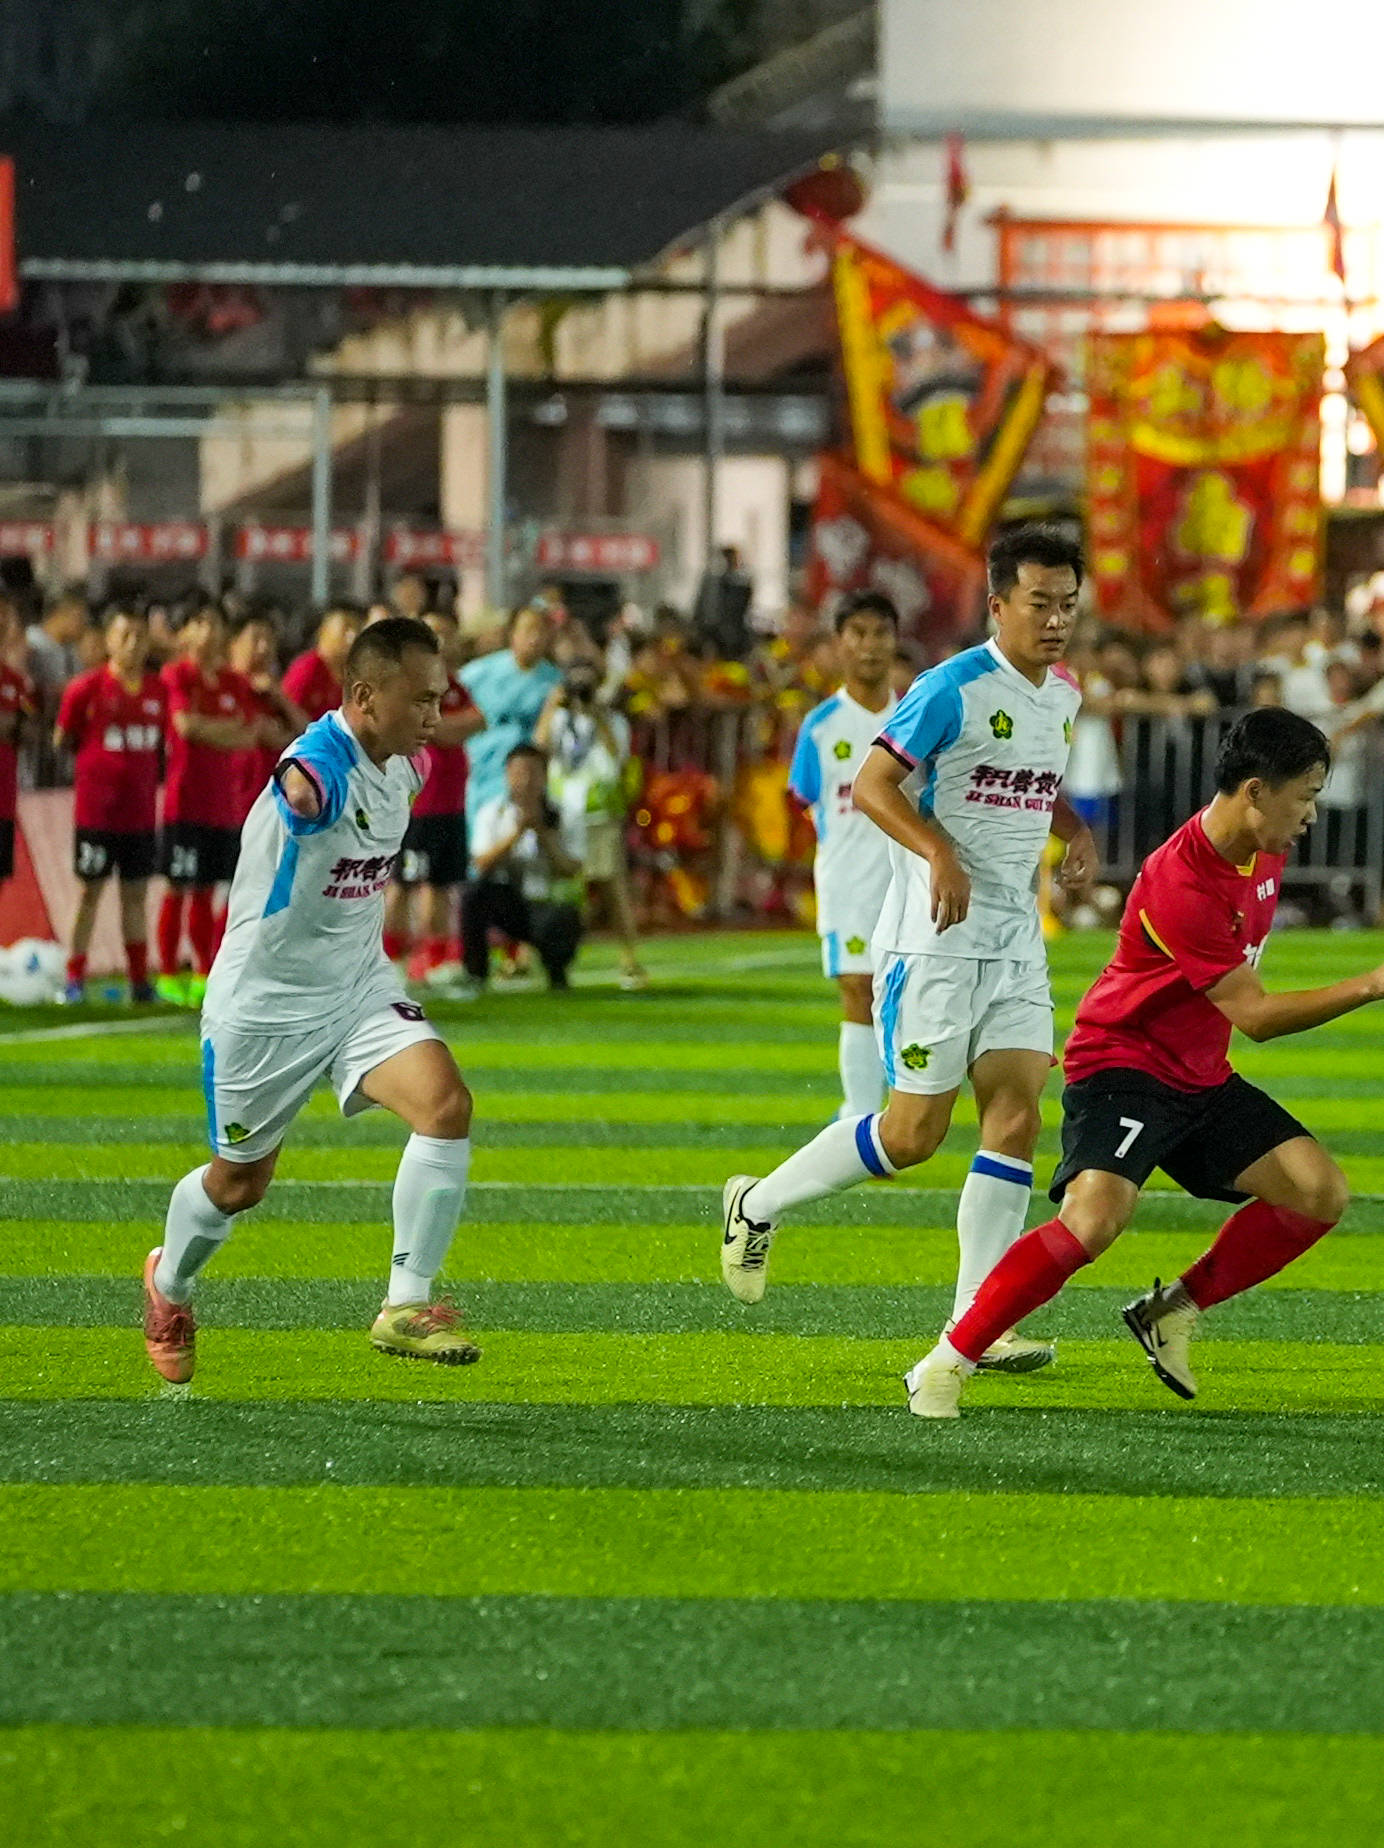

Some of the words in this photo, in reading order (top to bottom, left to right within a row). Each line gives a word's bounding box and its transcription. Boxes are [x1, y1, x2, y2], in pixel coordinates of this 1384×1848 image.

[969, 764, 1063, 796] 积善贵
[984, 794, 1022, 809] SHAN
[1114, 1116, 1145, 1159] 7
